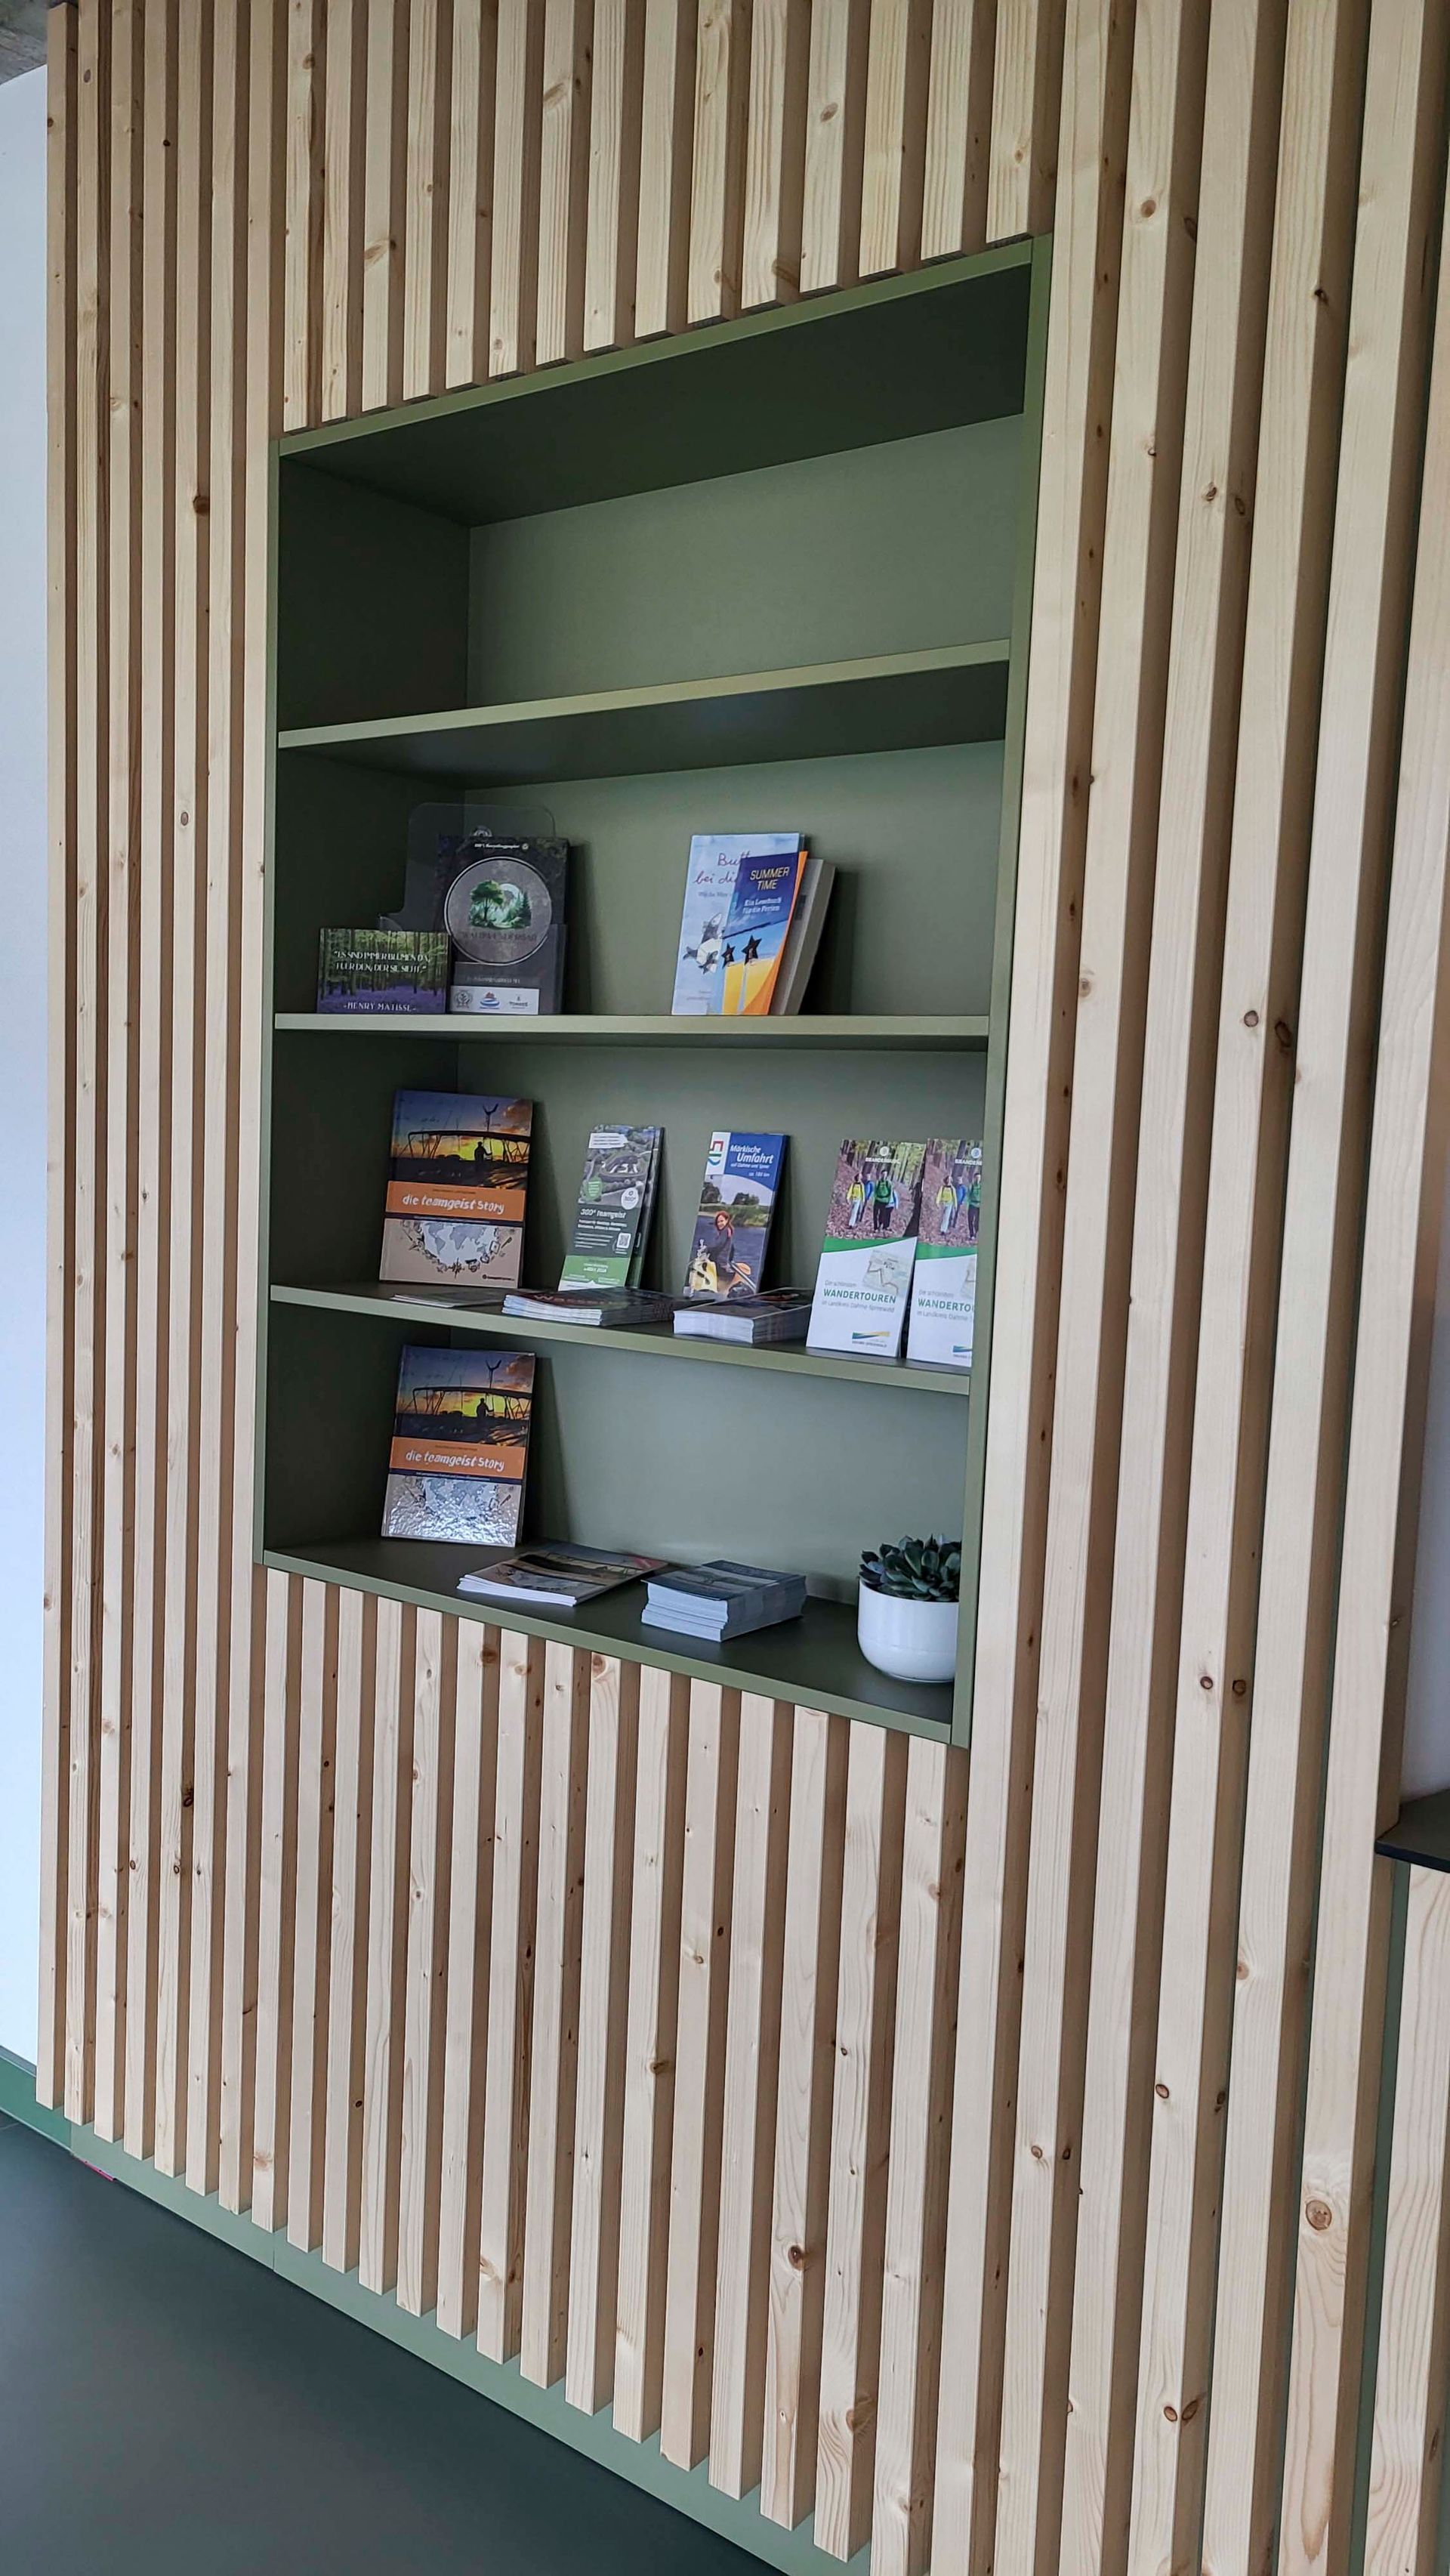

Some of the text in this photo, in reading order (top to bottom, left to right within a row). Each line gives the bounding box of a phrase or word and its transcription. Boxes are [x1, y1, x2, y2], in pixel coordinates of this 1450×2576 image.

[693, 871, 714, 885] bei
[750, 866, 790, 881] SUMMER
[757, 879, 779, 891] TIME
[730, 1144, 761, 1154] Märkische
[736, 1152, 774, 1164] Umfahrt
[403, 1194, 504, 1215] die teamgeist Story
[823, 1288, 896, 1304] WANDERTOUREN
[918, 1298, 974, 1312] WANDERTO
[406, 1450, 504, 1472] die teamgeist Story
